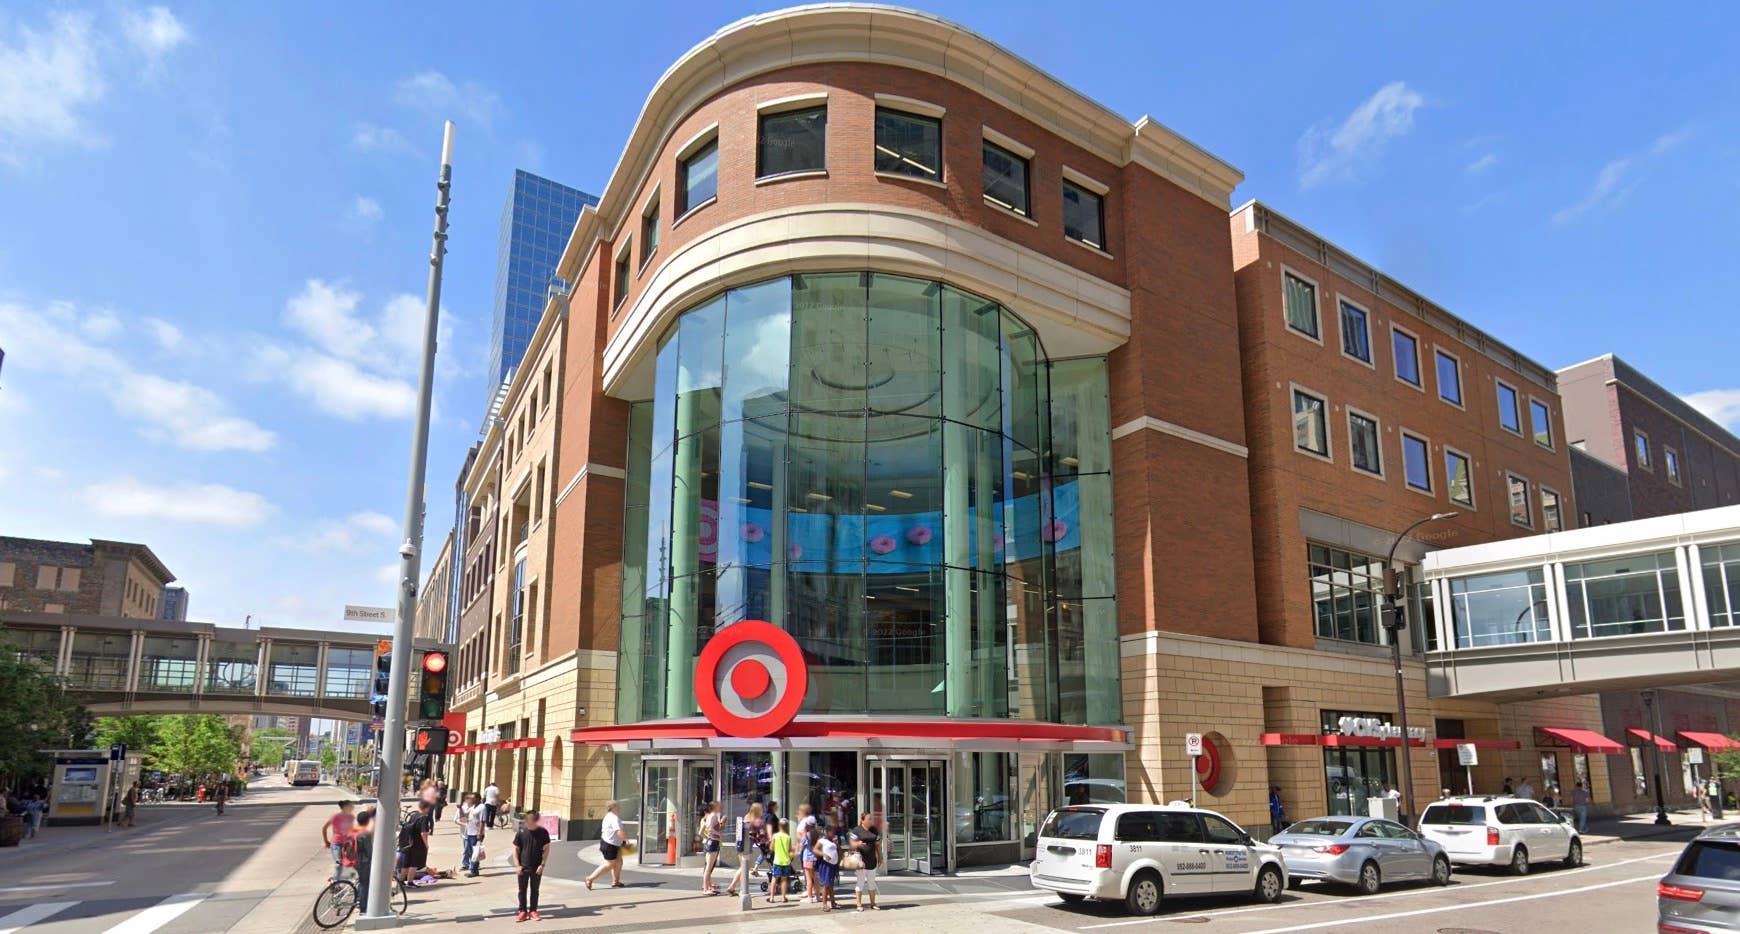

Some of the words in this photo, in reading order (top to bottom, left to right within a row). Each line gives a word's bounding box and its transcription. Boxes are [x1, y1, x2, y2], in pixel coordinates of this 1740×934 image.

[346, 608, 358, 617] 9th
[360, 610, 379, 618] Street
[1078, 847, 1092, 856] 3811
[1130, 845, 1142, 853] 3811
